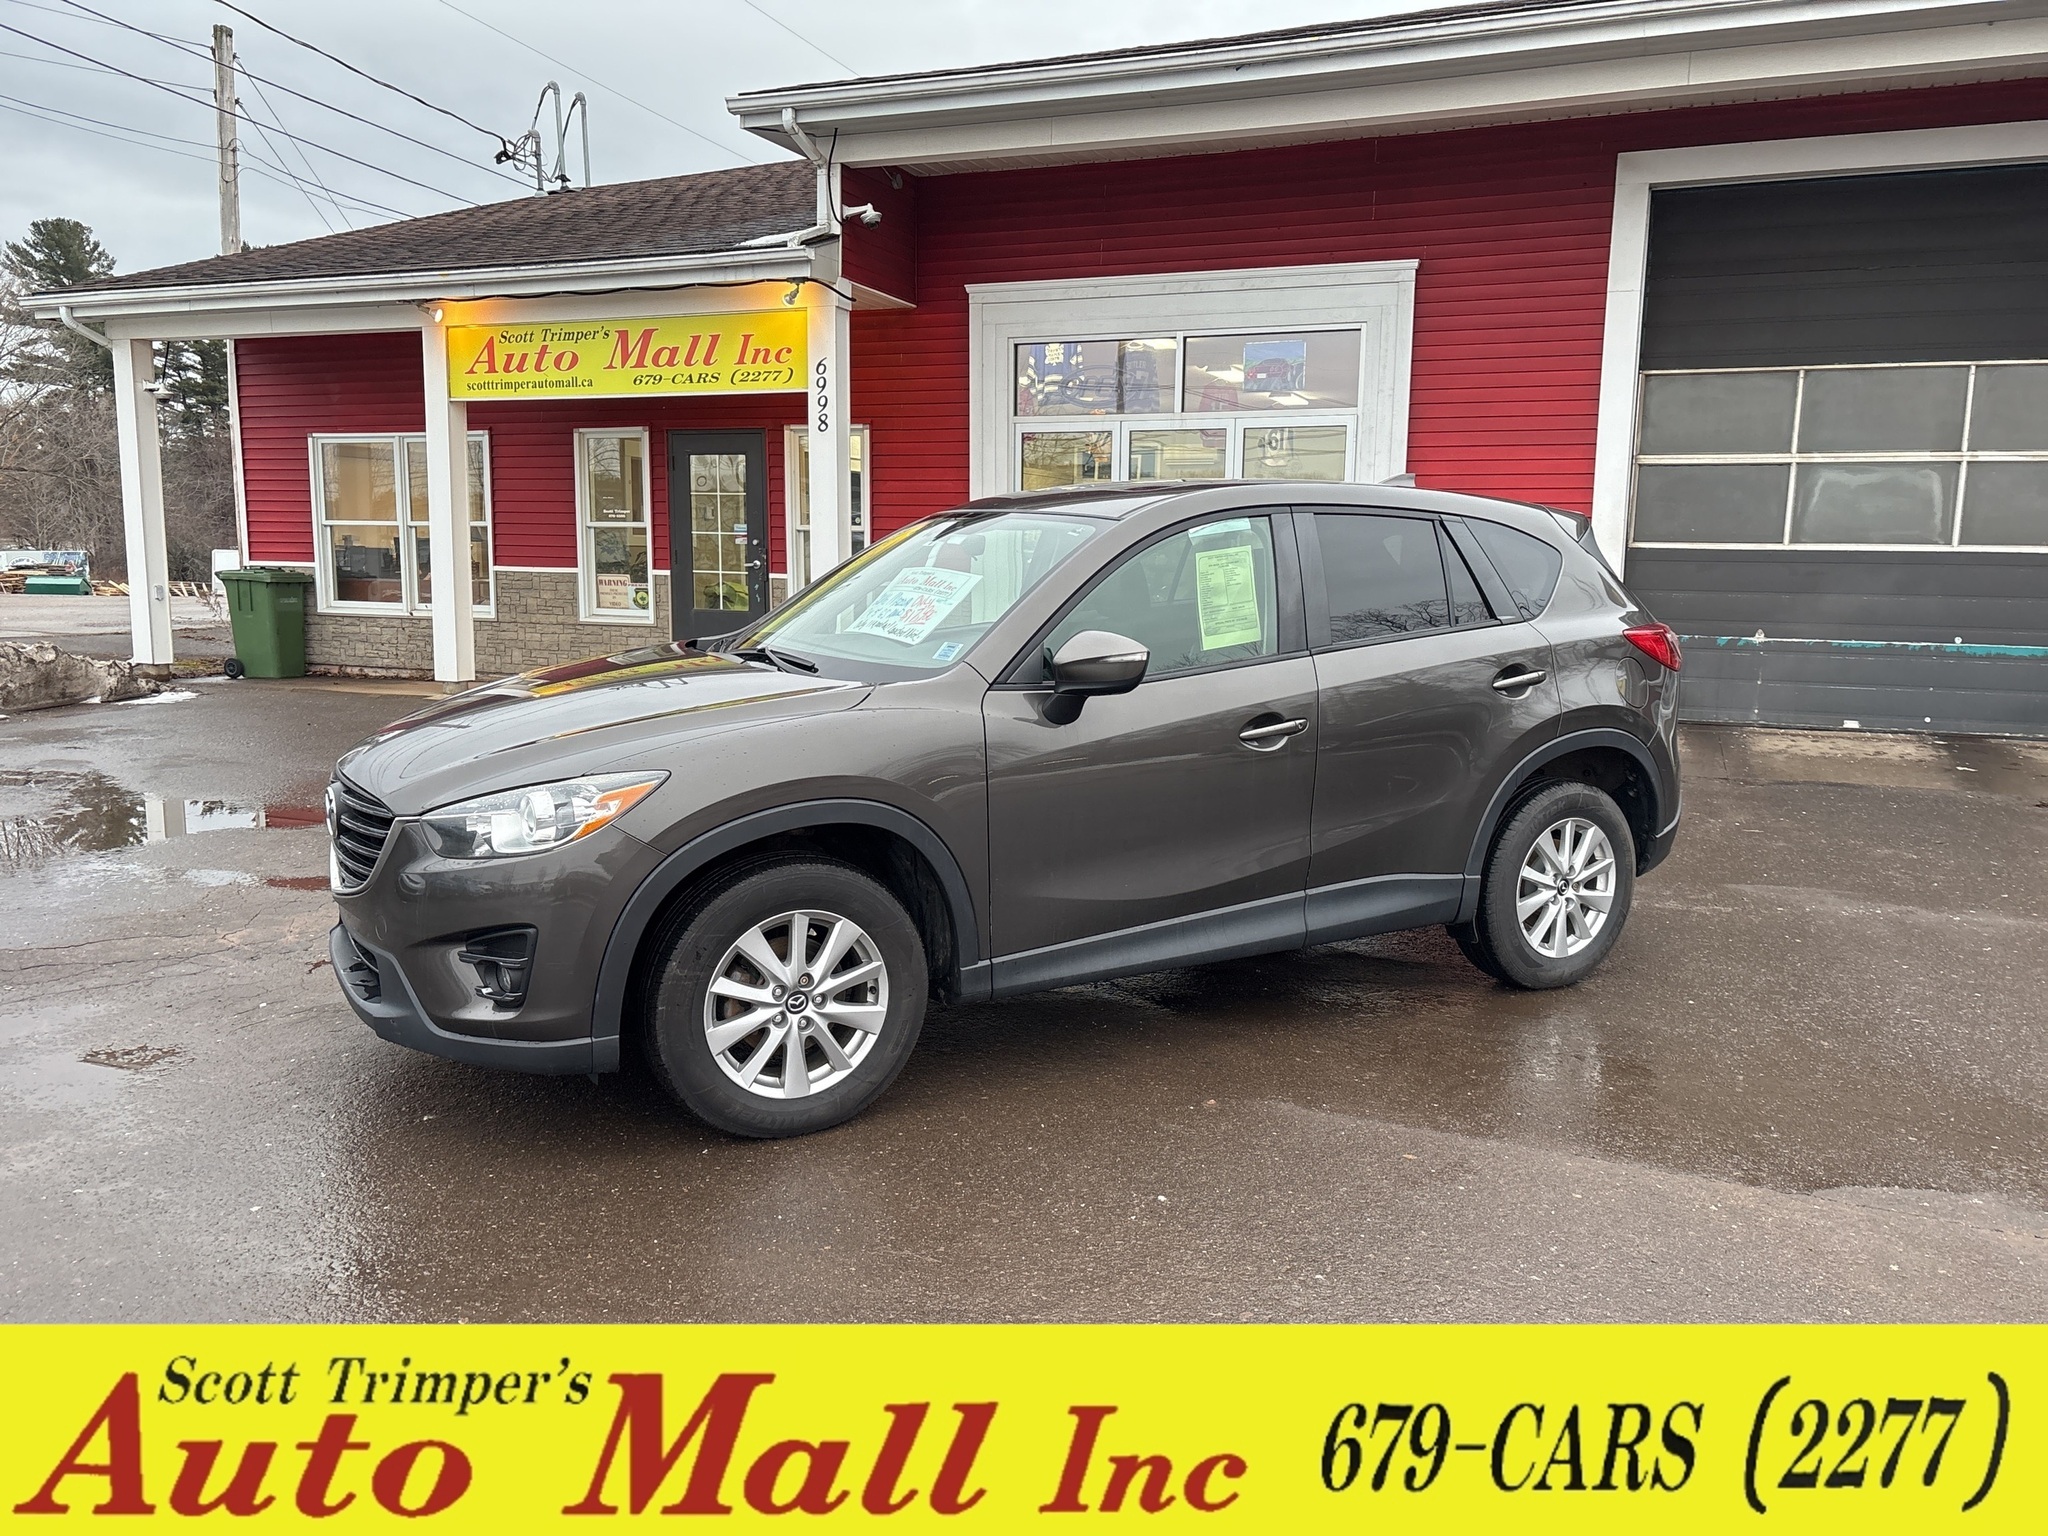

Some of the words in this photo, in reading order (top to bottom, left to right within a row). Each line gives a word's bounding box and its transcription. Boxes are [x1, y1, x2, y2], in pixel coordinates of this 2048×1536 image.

[499, 330, 535, 344] Scott
[540, 326, 611, 345] Trimper's
[464, 335, 579, 375] Auto
[602, 328, 721, 370] Mall
[733, 333, 793, 366] Inc
[466, 376, 593, 392] scotttrimperautomall.ca
[632, 371, 721, 386] 679-CARS
[730, 367, 794, 385] (2277)
[815, 356, 829, 433] 6998
[598, 579, 628, 587] WARNING
